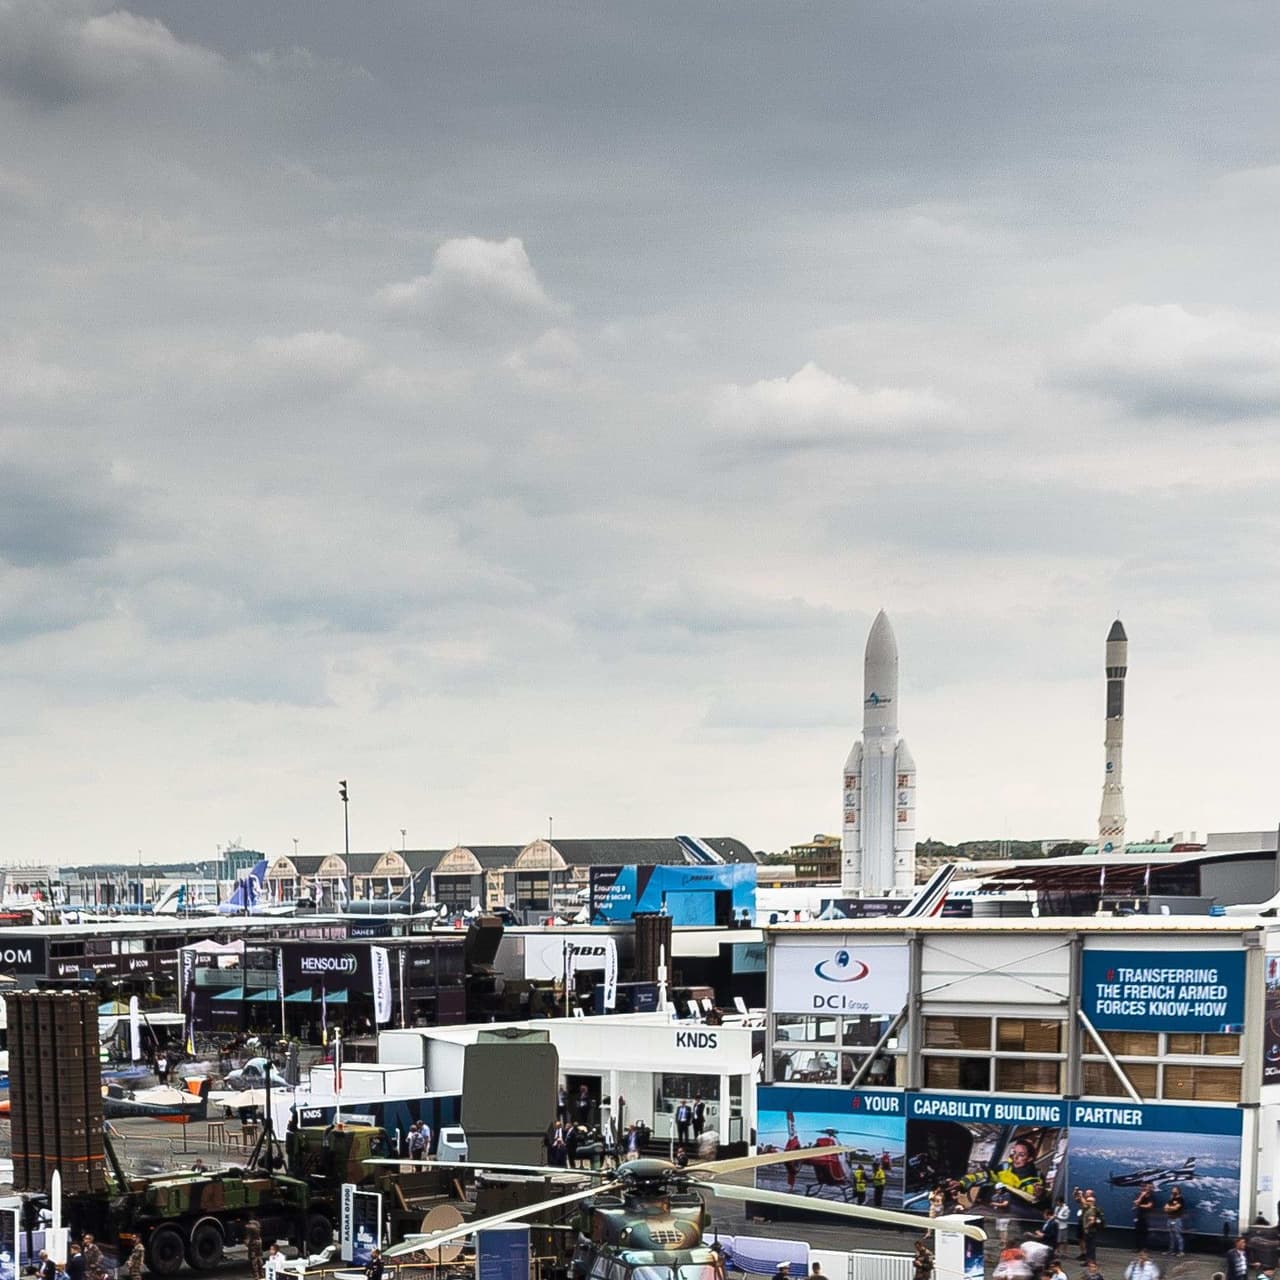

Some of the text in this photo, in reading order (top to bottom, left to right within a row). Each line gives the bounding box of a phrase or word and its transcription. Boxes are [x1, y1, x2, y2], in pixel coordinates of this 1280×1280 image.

[593, 892, 631, 901] more secure
[593, 900, 613, 909] future
[563, 943, 606, 956] MBD
[301, 957, 353, 970] HENSOLDT
[1118, 968, 1218, 984] TRANSFERRING
[1096, 984, 1228, 1001] THE FRENCH ARMED
[813, 995, 847, 1009] DCI
[1096, 1000, 1227, 1017] FORCES KNOW-HOW
[676, 1031, 718, 1049] KNDS
[302, 1109, 322, 1119] KNDS
[864, 1096, 900, 1112] YOUR
[913, 1099, 991, 1119] CAPABILITY
[994, 1103, 1060, 1122] BUILDING
[1075, 1106, 1143, 1126] PARTNER
